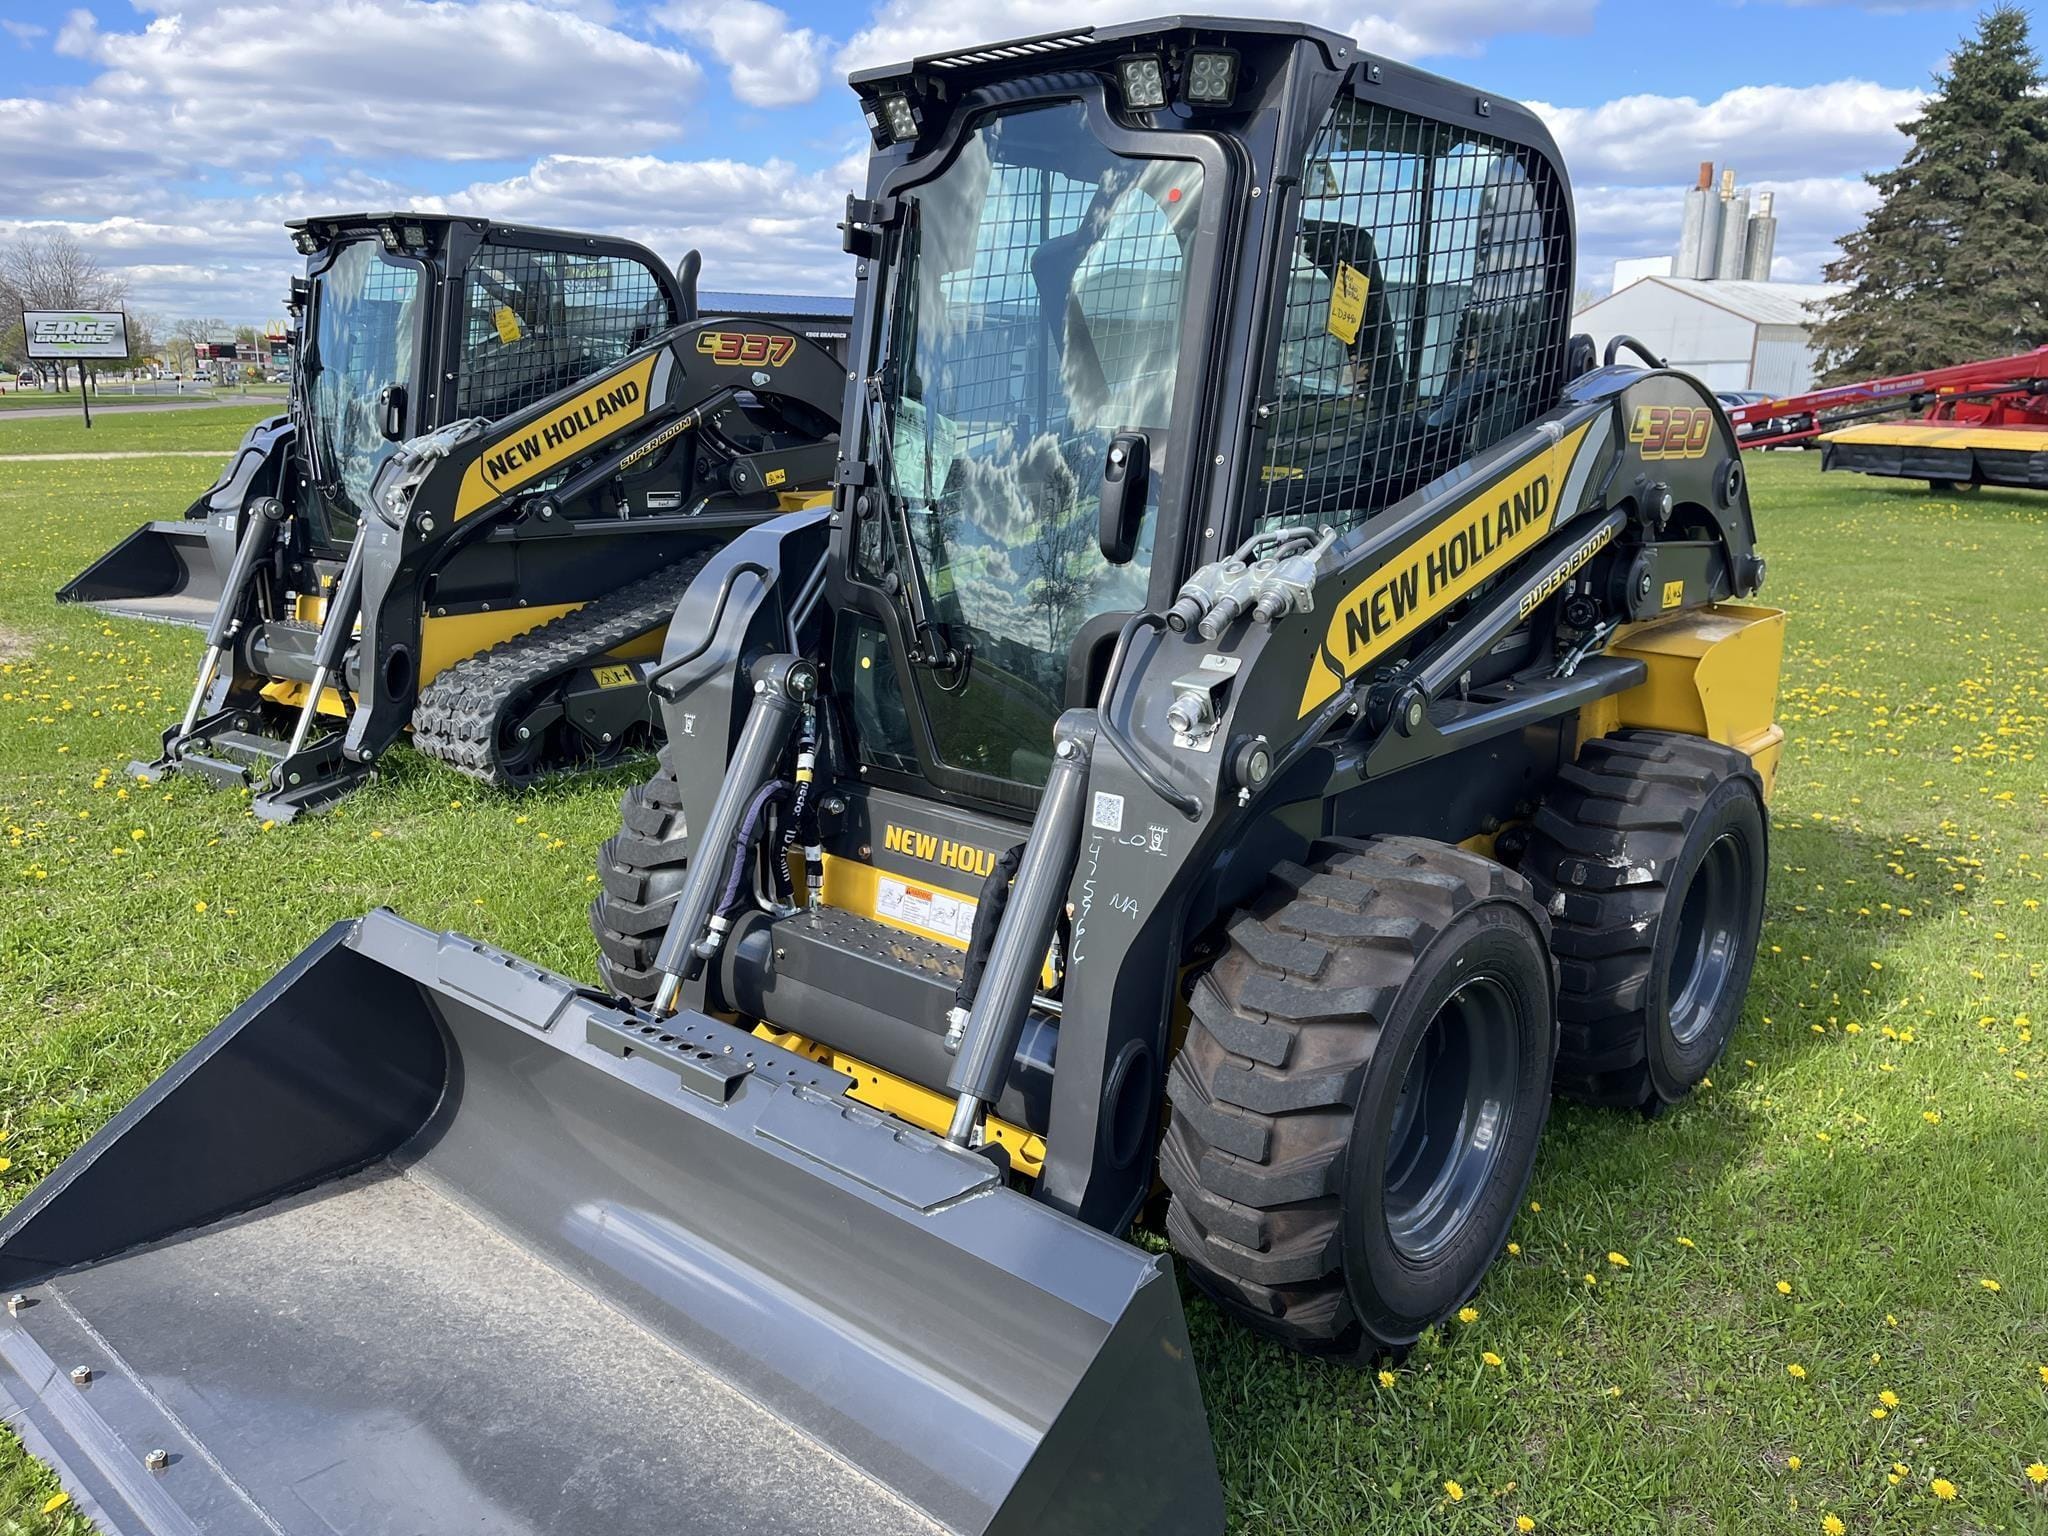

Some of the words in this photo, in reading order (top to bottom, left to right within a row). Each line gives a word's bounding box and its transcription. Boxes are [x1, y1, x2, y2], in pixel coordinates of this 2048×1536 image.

[34, 321, 116, 335] EDGE
[34, 334, 114, 344] GRAPHICS
[697, 331, 796, 367] C337
[486, 434, 541, 481] NEW
[542, 380, 640, 449] HOLLAND
[620, 437, 659, 470] SUPER
[658, 416, 692, 445] BOOM
[1630, 406, 1713, 460] L320
[1345, 561, 1419, 657] NEW
[1426, 473, 1550, 599] HOLLAND
[1519, 561, 1570, 620] SUPER
[1570, 524, 1612, 576] BOOM
[885, 824, 938, 862] NEW
[940, 839, 996, 877] HOLL
